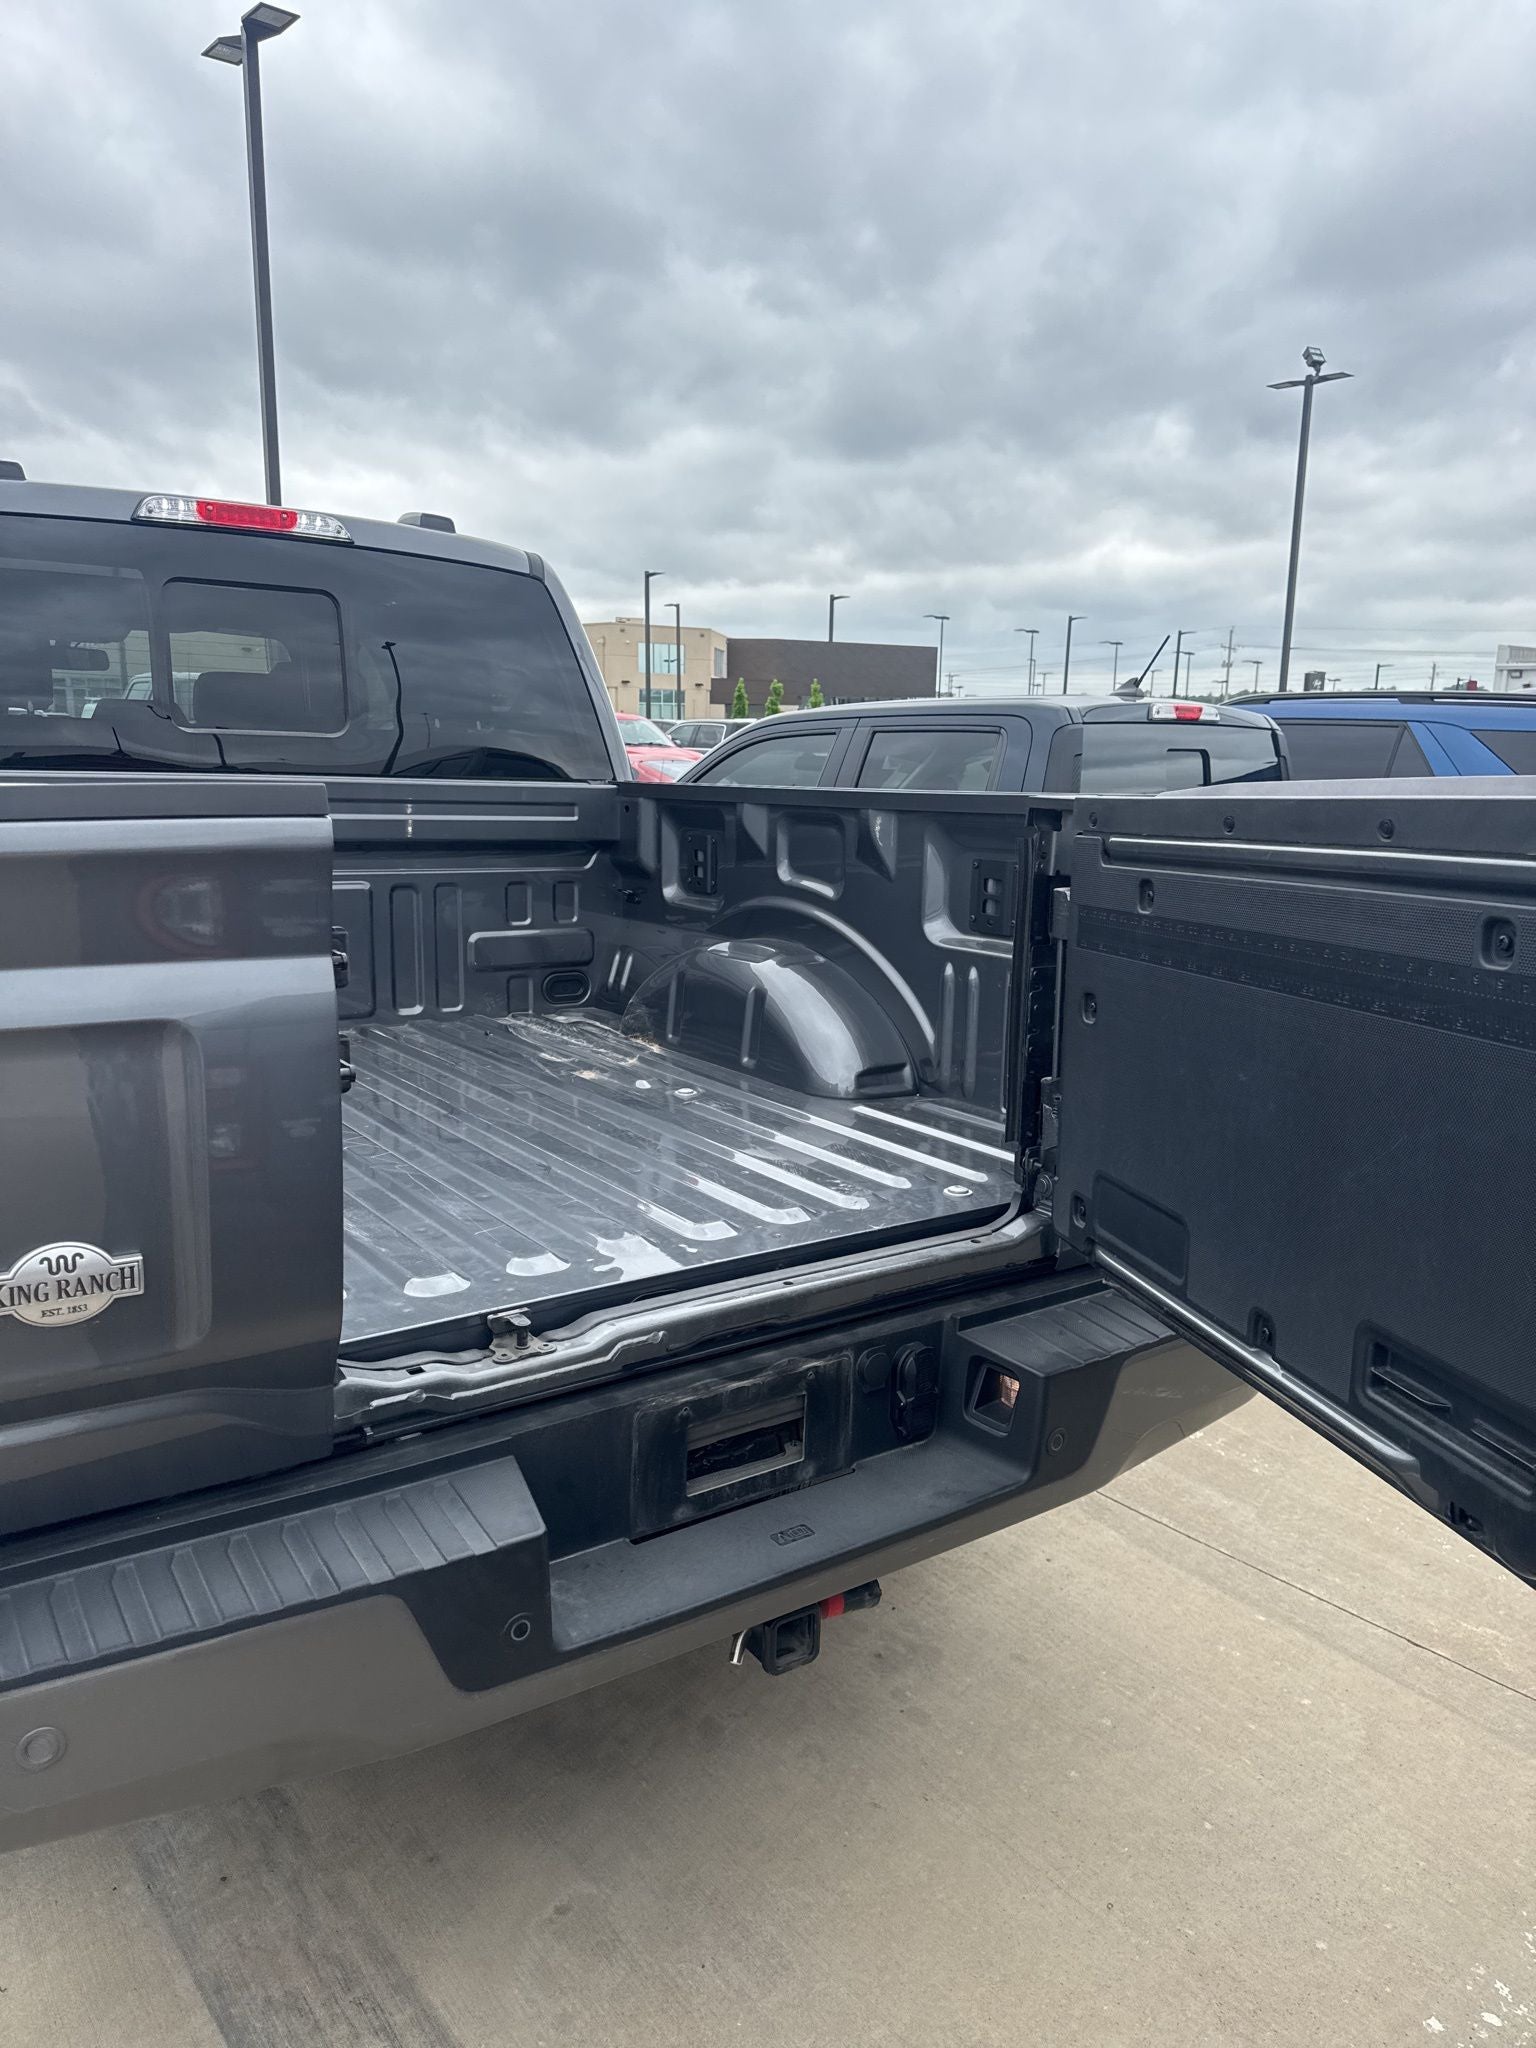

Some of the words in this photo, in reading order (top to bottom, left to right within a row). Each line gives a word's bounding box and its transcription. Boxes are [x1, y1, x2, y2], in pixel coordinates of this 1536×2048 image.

[56, 1266, 137, 1300] RANCH
[41, 1308, 65, 1319] EST.
[67, 1304, 89, 1314] 1853
